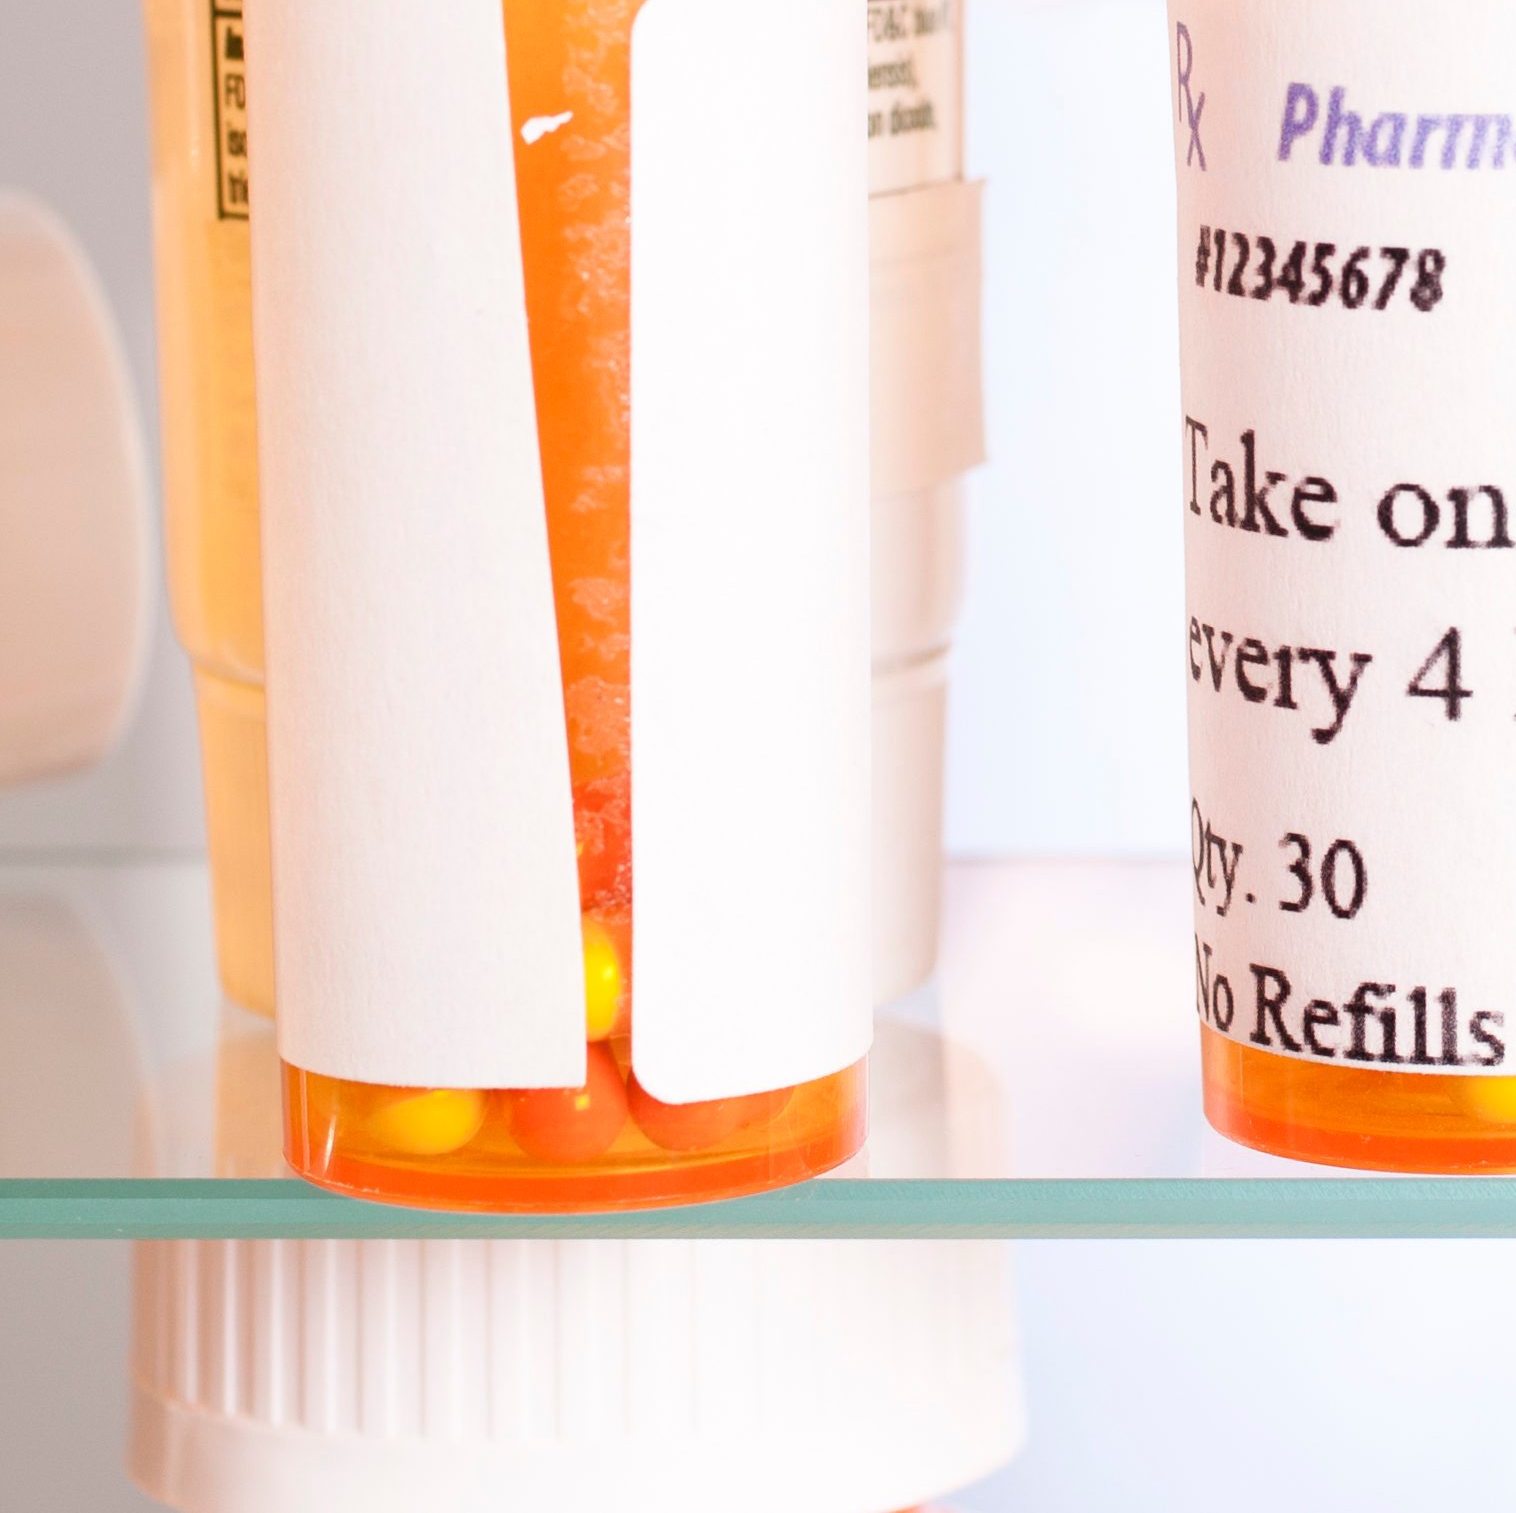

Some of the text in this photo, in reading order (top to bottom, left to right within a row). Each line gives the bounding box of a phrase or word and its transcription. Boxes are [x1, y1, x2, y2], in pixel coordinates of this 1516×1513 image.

[1195, 224, 1446, 312] #12345678
[1186, 415, 1339, 543] Take
[1189, 616, 1373, 745] every
[1407, 626, 1473, 722] 4
[1280, 832, 1368, 920] 30
[1195, 933, 1506, 1068] No Refills
